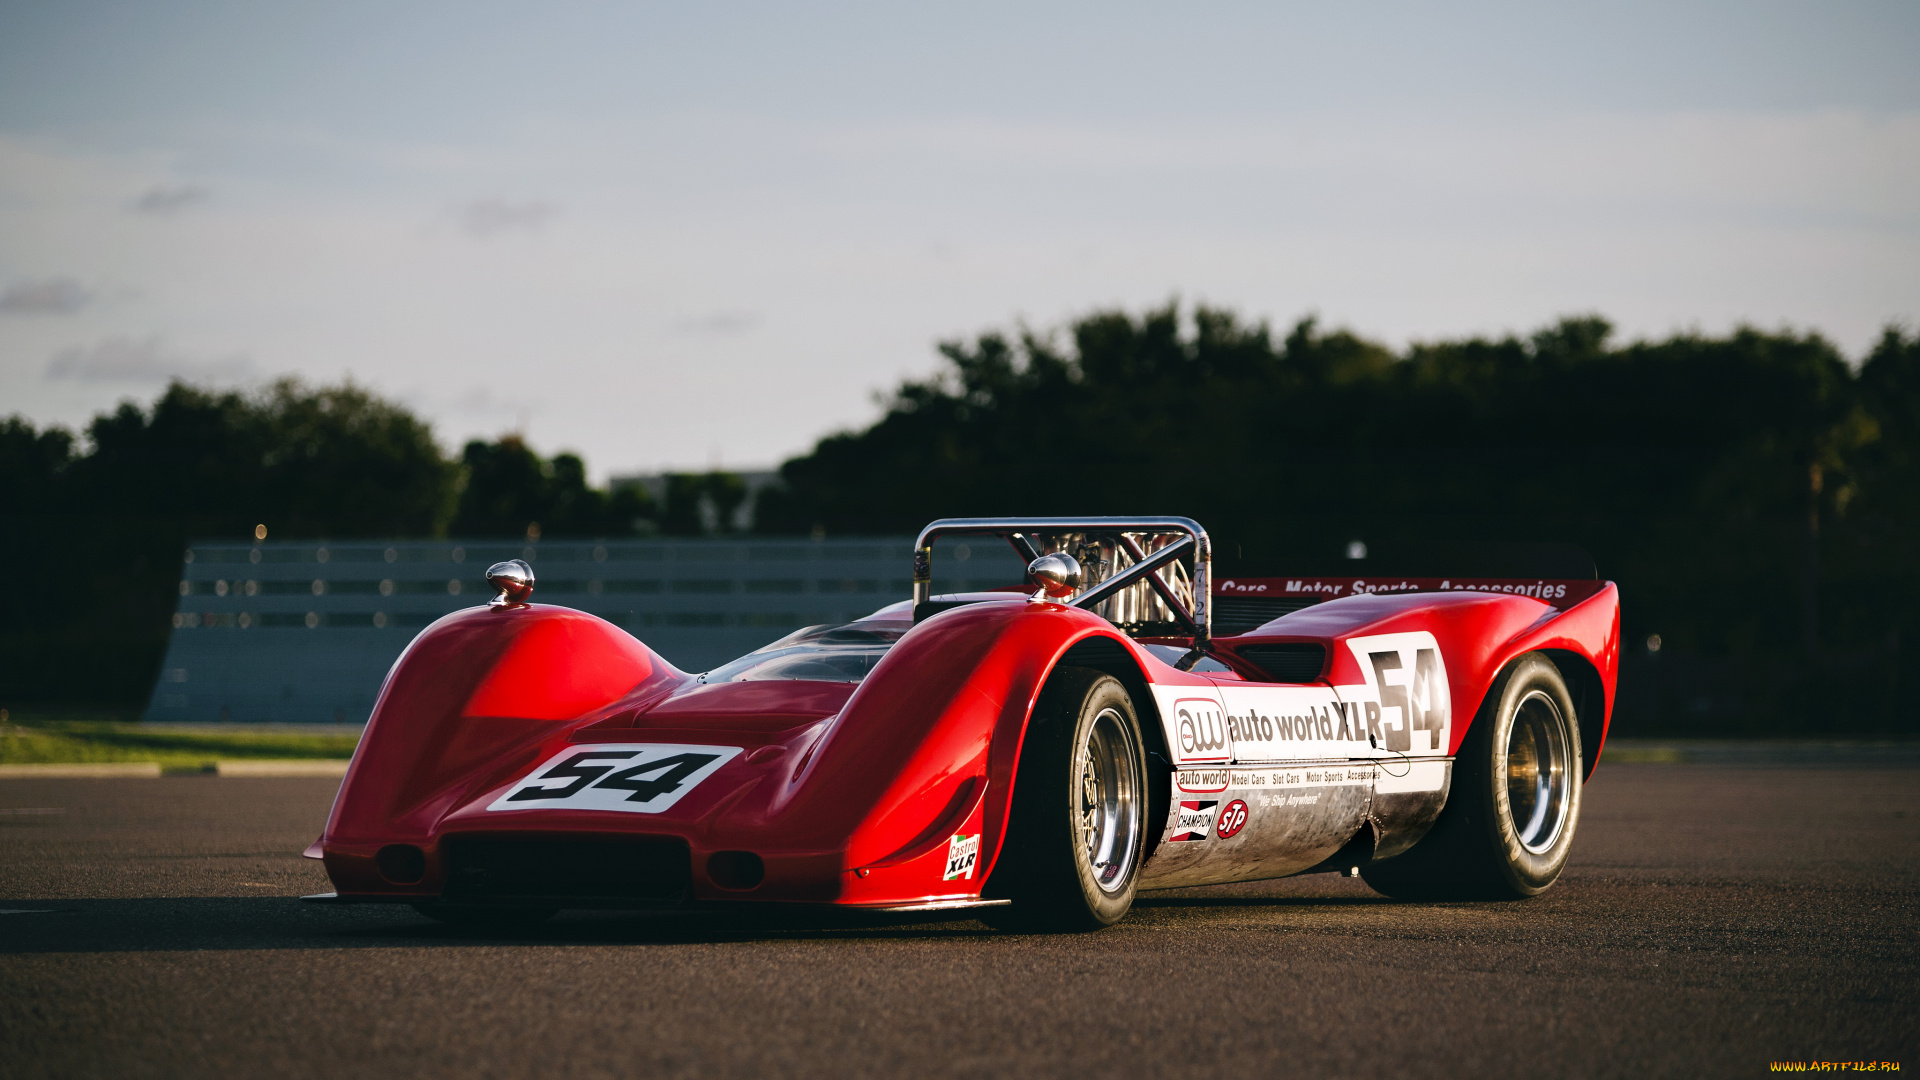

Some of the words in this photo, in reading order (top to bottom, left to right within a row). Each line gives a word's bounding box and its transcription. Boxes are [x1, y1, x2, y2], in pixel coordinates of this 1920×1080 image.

[1368, 648, 1446, 752] 54
[1229, 708, 1274, 742] auto
[1274, 705, 1334, 742] world
[1330, 701, 1384, 742] XLR
[506, 751, 723, 803] 54
[1179, 769, 1201, 785] auto
[1202, 768, 1227, 785] world
[1231, 773, 1250, 785] Model
[1251, 773, 1266, 785] Cars
[1272, 773, 1285, 785] Slot
[1286, 772, 1300, 784] Cars
[1306, 771, 1322, 783] Motor
[1325, 770, 1343, 783] Sports
[1271, 794, 1286, 808] Ship
[1177, 814, 1214, 828] CHAMPION
[1219, 803, 1246, 834] STP
[950, 837, 979, 860] Castrol
[946, 852, 976, 875] XLR
